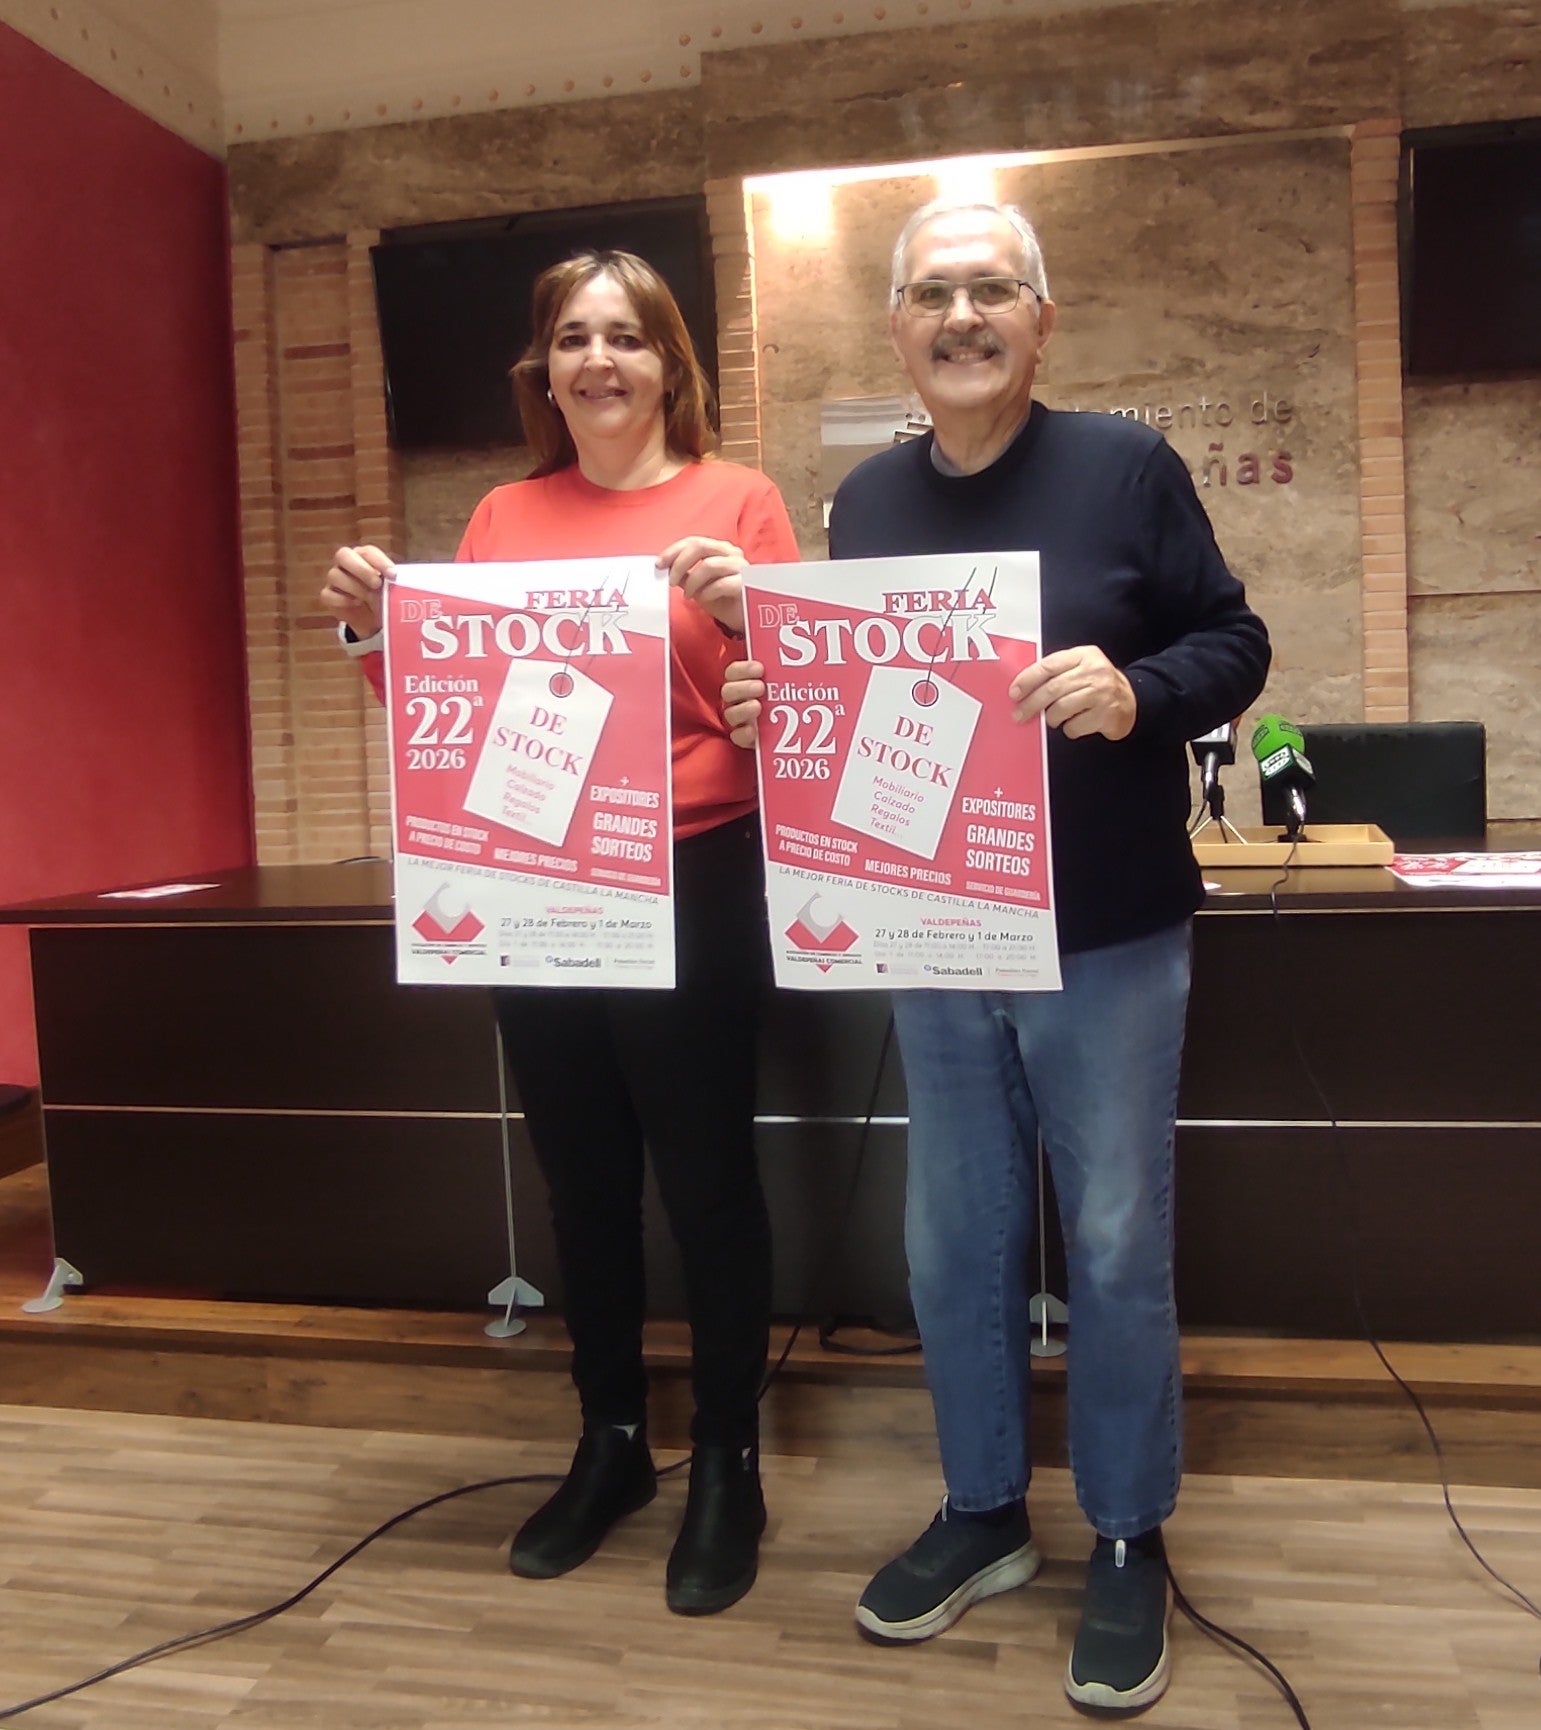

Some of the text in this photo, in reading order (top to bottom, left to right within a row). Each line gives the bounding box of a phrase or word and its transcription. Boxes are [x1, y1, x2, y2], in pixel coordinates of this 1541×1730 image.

[1250, 391, 1293, 425] de
[1202, 442, 1294, 488] ñas
[400, 599, 443, 623] DE
[525, 588, 630, 610] FERIA
[882, 588, 997, 615] FERIA
[758, 603, 801, 629] DE
[420, 611, 633, 660] STOCK
[778, 612, 1000, 667] STOCK
[404, 674, 479, 694] Edición
[766, 682, 840, 702] Edición
[529, 706, 568, 736] DE
[893, 714, 934, 747] DE
[405, 748, 467, 770] 2026
[492, 726, 584, 777] STOCK
[857, 736, 954, 788] STOCK
[773, 757, 831, 780] 2026
[873, 776, 925, 803] Mobiliario
[874, 791, 916, 814] Calzado
[871, 803, 912, 827] Regalos
[962, 797, 1036, 821] EXPOSITORES
[593, 811, 658, 838] GRANDES
[966, 824, 1035, 852] GRANDES
[591, 835, 653, 863] SORTEOS
[775, 824, 859, 854] PRODUCTOS EN STOCK
[779, 839, 851, 867] A PRECIO DE COSTO
[965, 848, 1031, 877] SORTEOS
[864, 858, 952, 886] MEJORES PRECIOS
[779, 866, 1040, 919] LA MEJOR FERIA DE STOCKS DE CASTILLA LA MANCHA
[500, 917, 512, 928] 27
[514, 920, 520, 929] y
[536, 918, 548, 928] de
[550, 918, 588, 928] Febrero
[590, 920, 597, 930] y
[605, 919, 618, 929] de
[620, 919, 652, 929] Marzo
[875, 928, 886, 938] 27
[888, 931, 895, 940] y
[897, 929, 910, 939] 28
[911, 929, 924, 939] de
[926, 929, 966, 940] Febrero
[968, 933, 975, 942] y
[984, 931, 997, 941] de
[999, 931, 1034, 942] Marzo
[920, 917, 982, 927] VALDEPEÑAS
[553, 957, 602, 968] Sabadell
[932, 965, 983, 976] Sabadell
